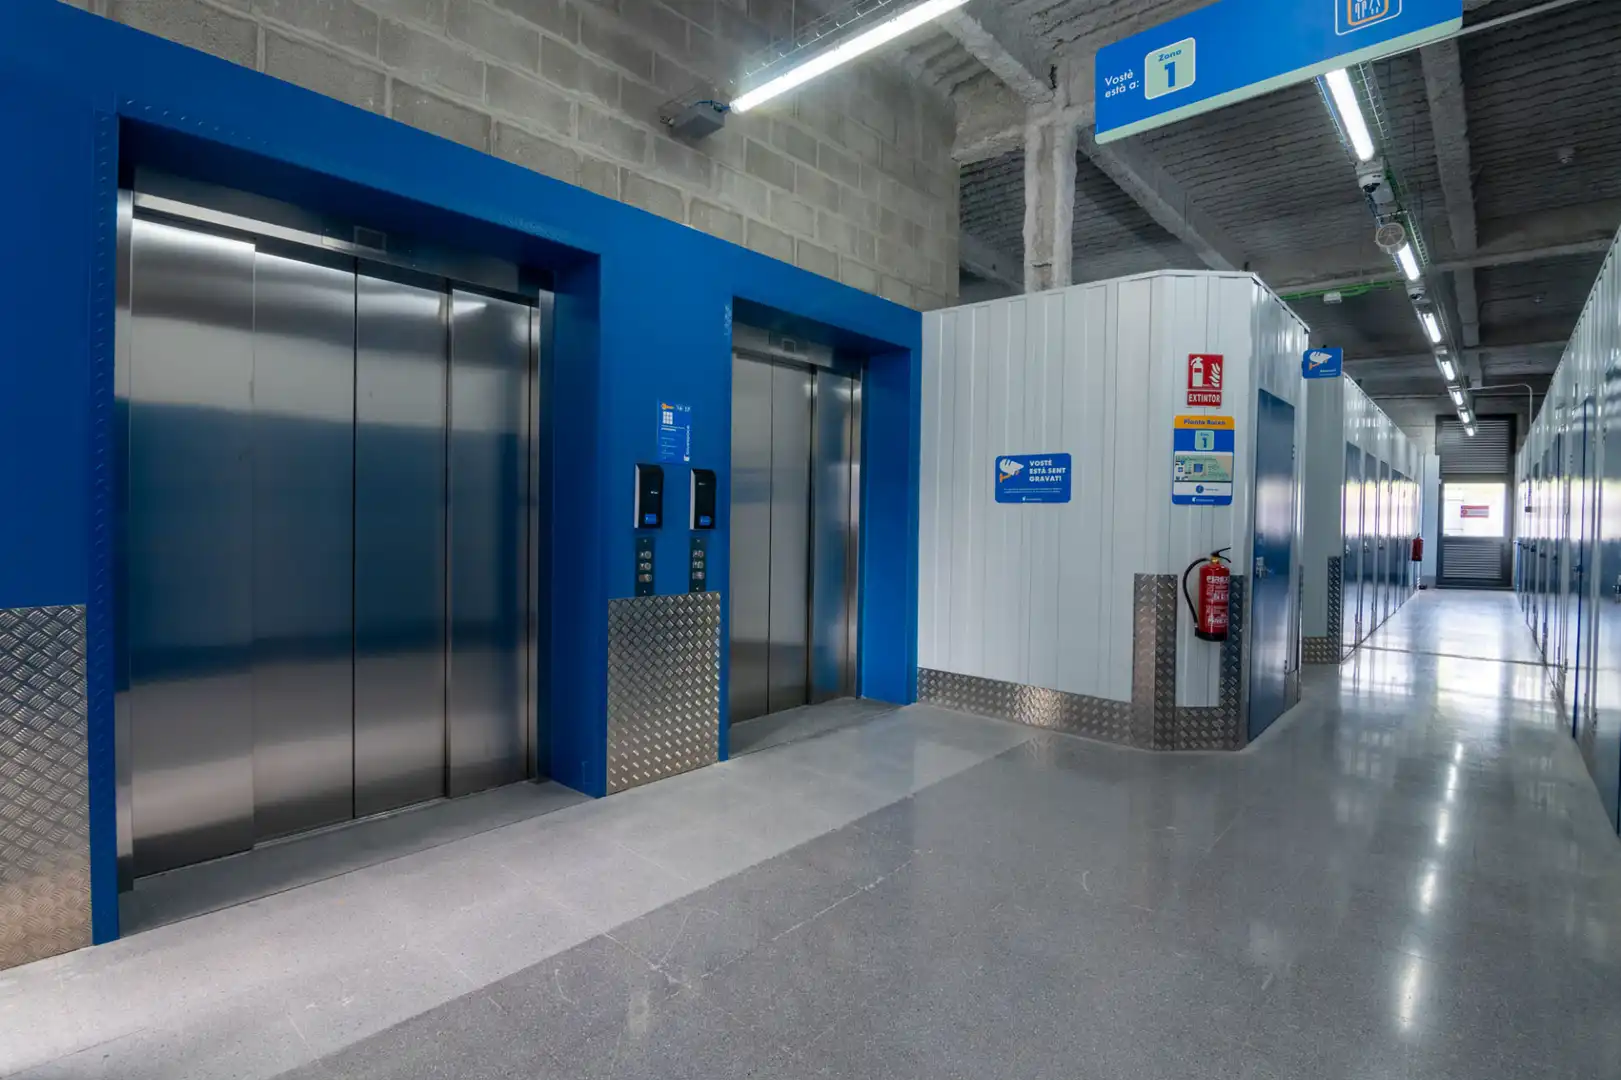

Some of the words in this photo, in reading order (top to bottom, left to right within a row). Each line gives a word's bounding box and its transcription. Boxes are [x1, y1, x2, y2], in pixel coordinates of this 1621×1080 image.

[1158, 49, 1182, 62] Zona
[1164, 61, 1176, 88] 1
[1128, 80, 1140, 90] a:
[1188, 393, 1221, 403] EXTINTOR
[1201, 437, 1208, 449] 1
[1047, 467, 1067, 475] SENT
